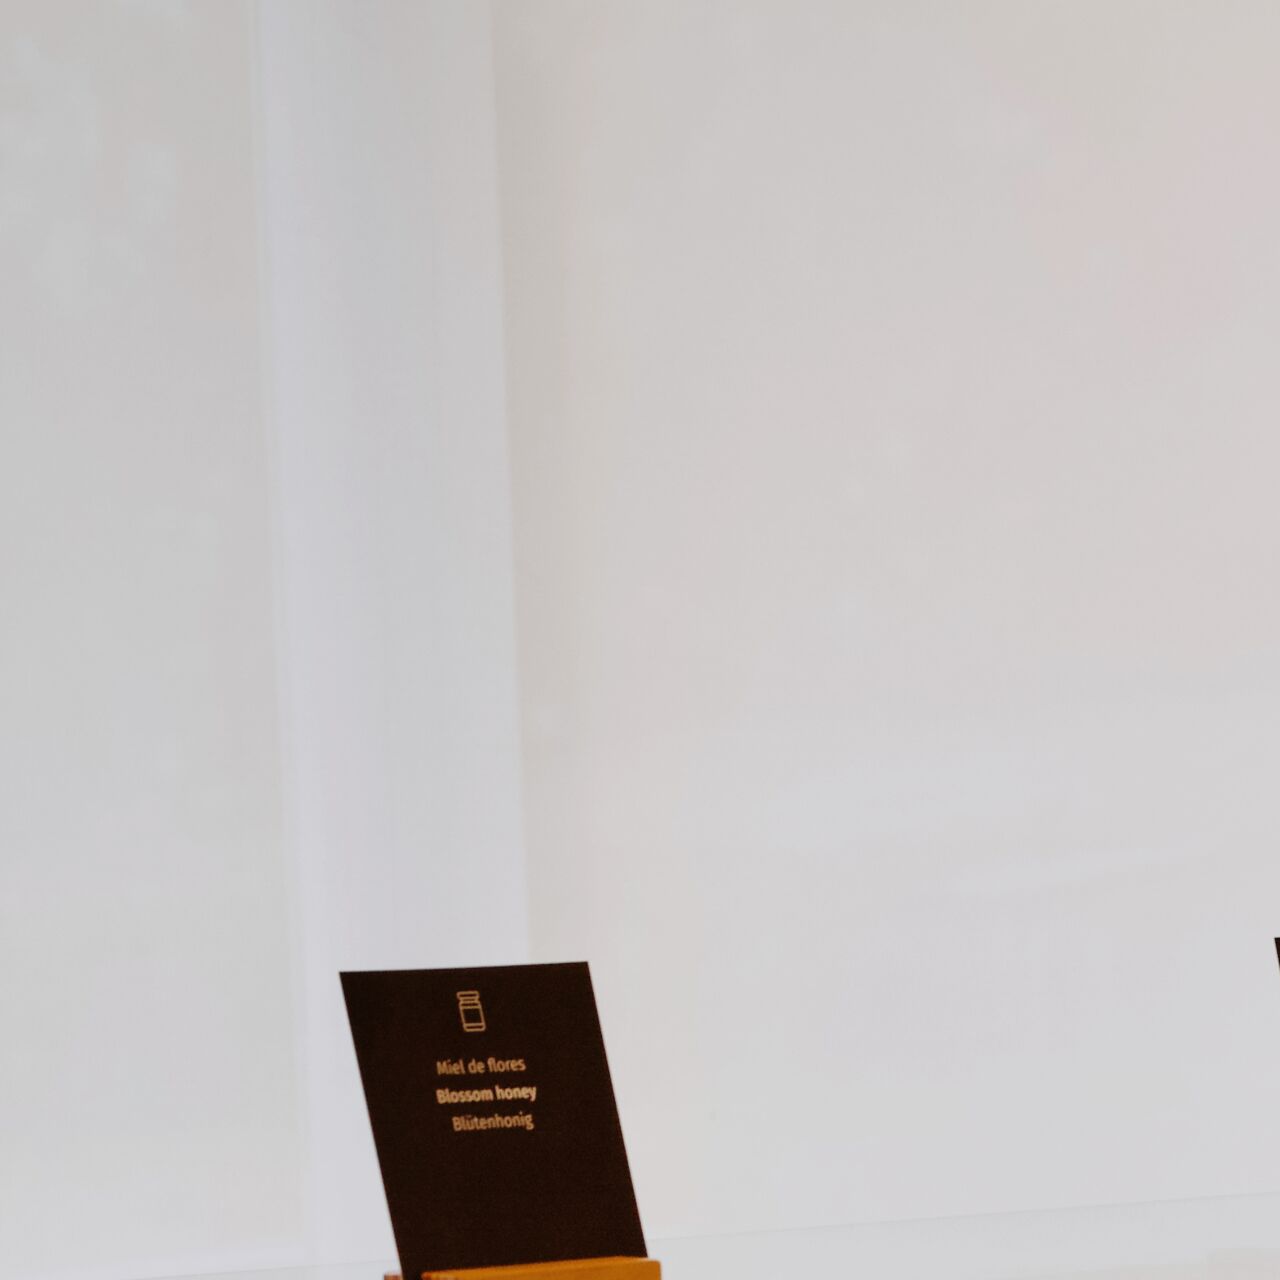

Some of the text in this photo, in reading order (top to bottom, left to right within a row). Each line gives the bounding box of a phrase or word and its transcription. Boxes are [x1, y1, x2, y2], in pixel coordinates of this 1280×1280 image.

[436, 1057, 527, 1075] Miel de flores
[436, 1084, 537, 1104] Blossom honey
[452, 1111, 534, 1132] Blütenhonig
